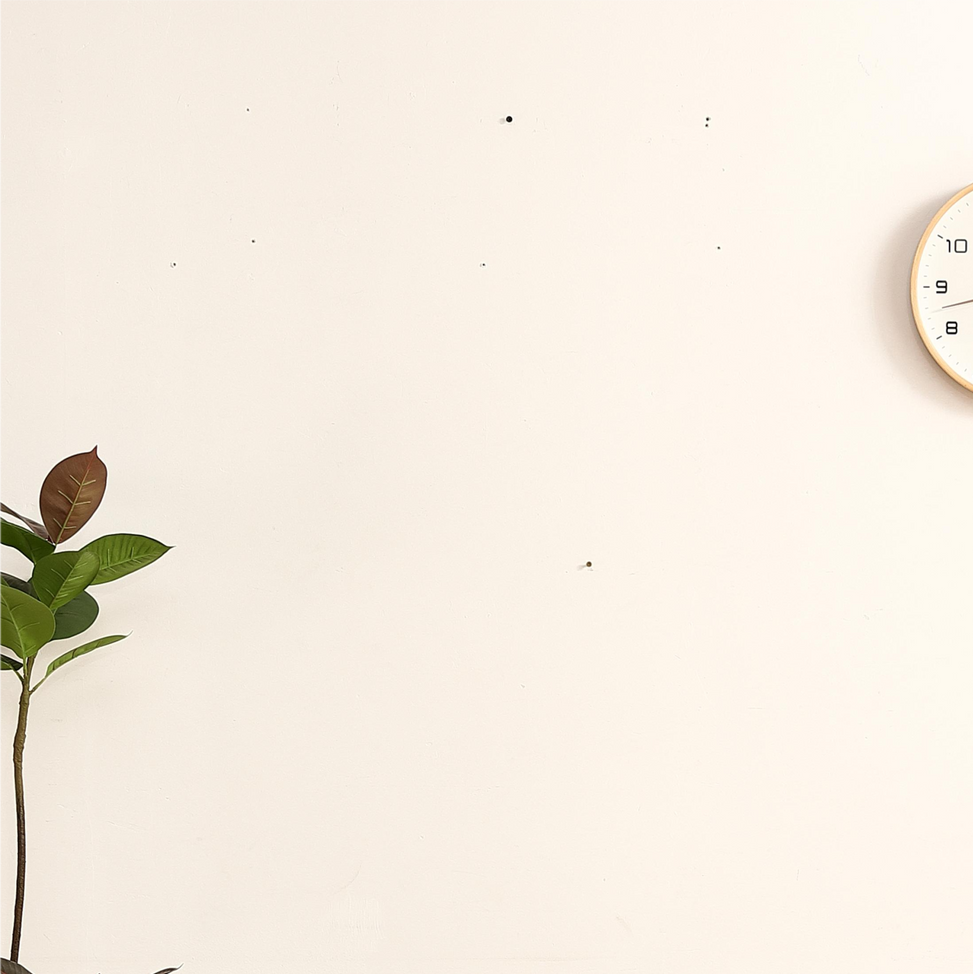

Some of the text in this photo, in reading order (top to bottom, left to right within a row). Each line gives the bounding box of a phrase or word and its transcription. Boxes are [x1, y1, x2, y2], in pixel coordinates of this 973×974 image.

[946, 238, 968, 253] 10
[935, 280, 948, 294] 9
[945, 320, 958, 335] 8
